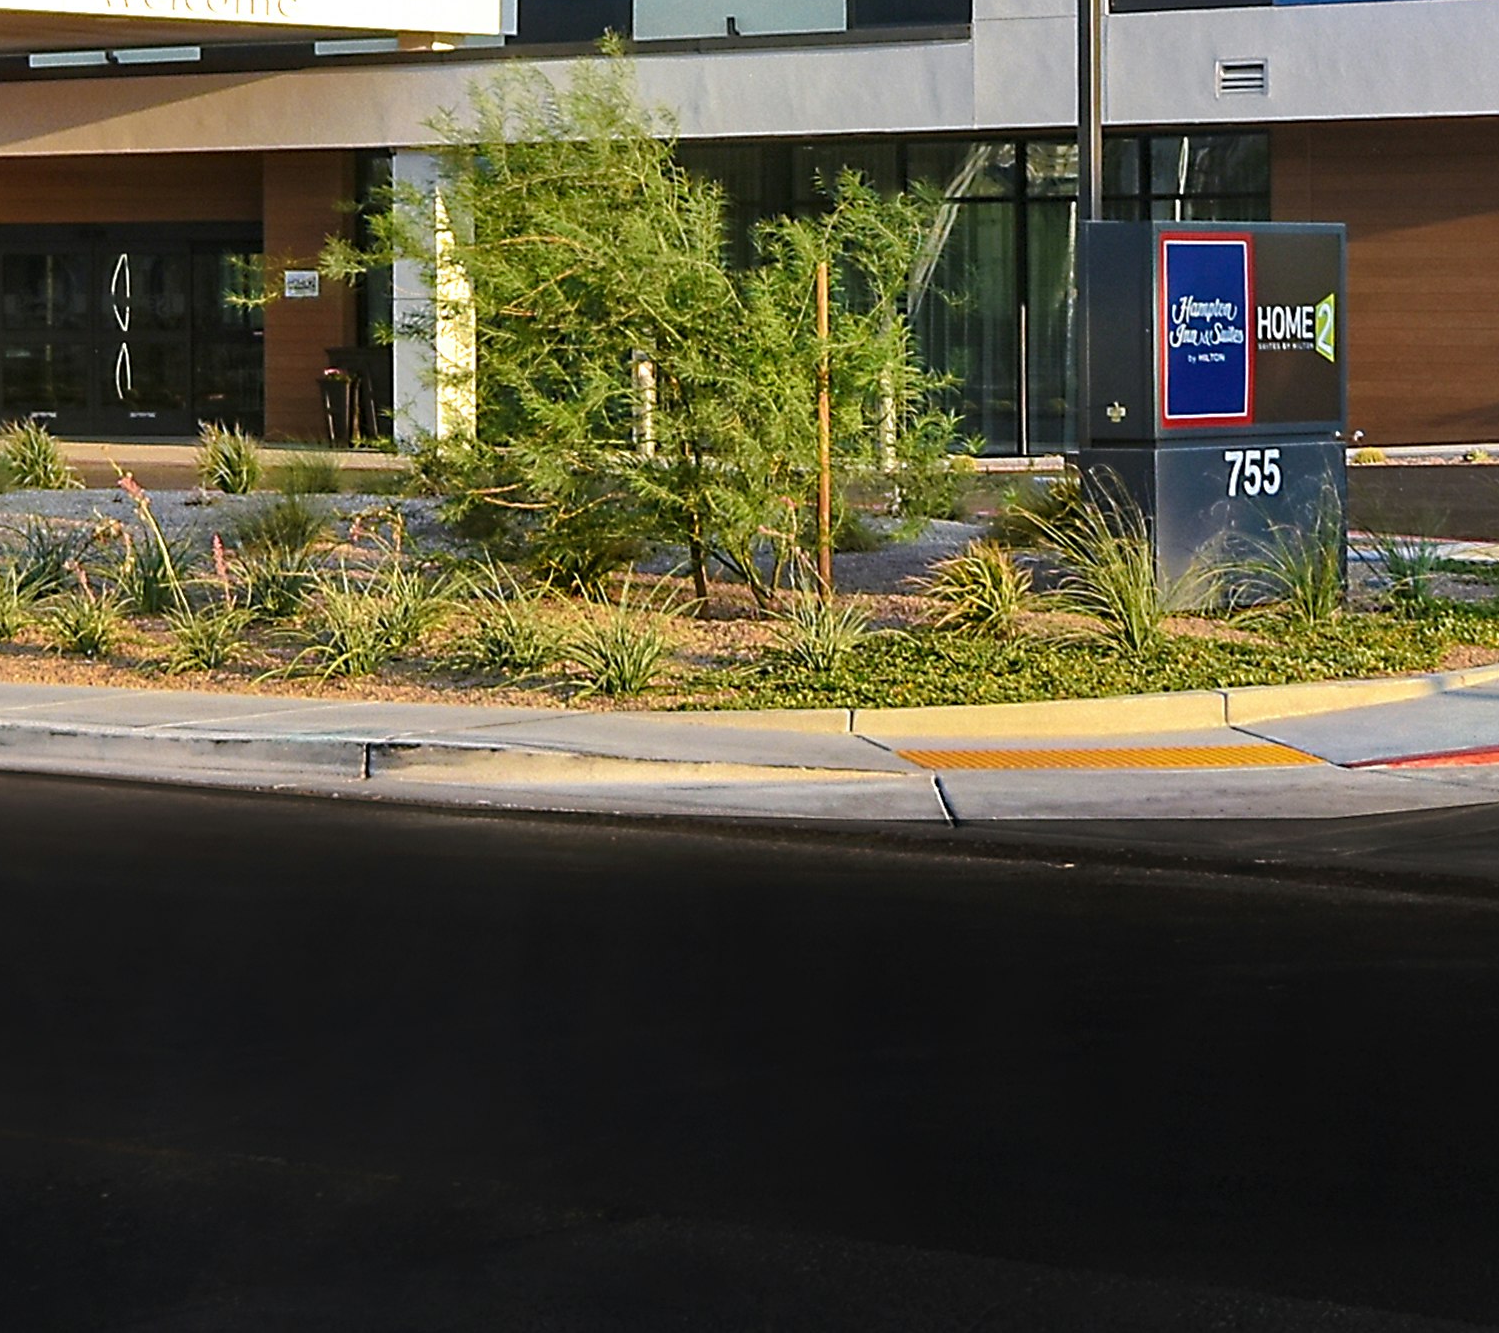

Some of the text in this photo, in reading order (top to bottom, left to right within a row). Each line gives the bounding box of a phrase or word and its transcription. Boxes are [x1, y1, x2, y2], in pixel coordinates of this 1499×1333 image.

[1171, 295, 1238, 325] Hampton
[1210, 322, 1244, 345] Suites
[1257, 302, 1333, 355] HOME 2
[1198, 352, 1226, 363] HILTON
[1224, 448, 1282, 498] 755
